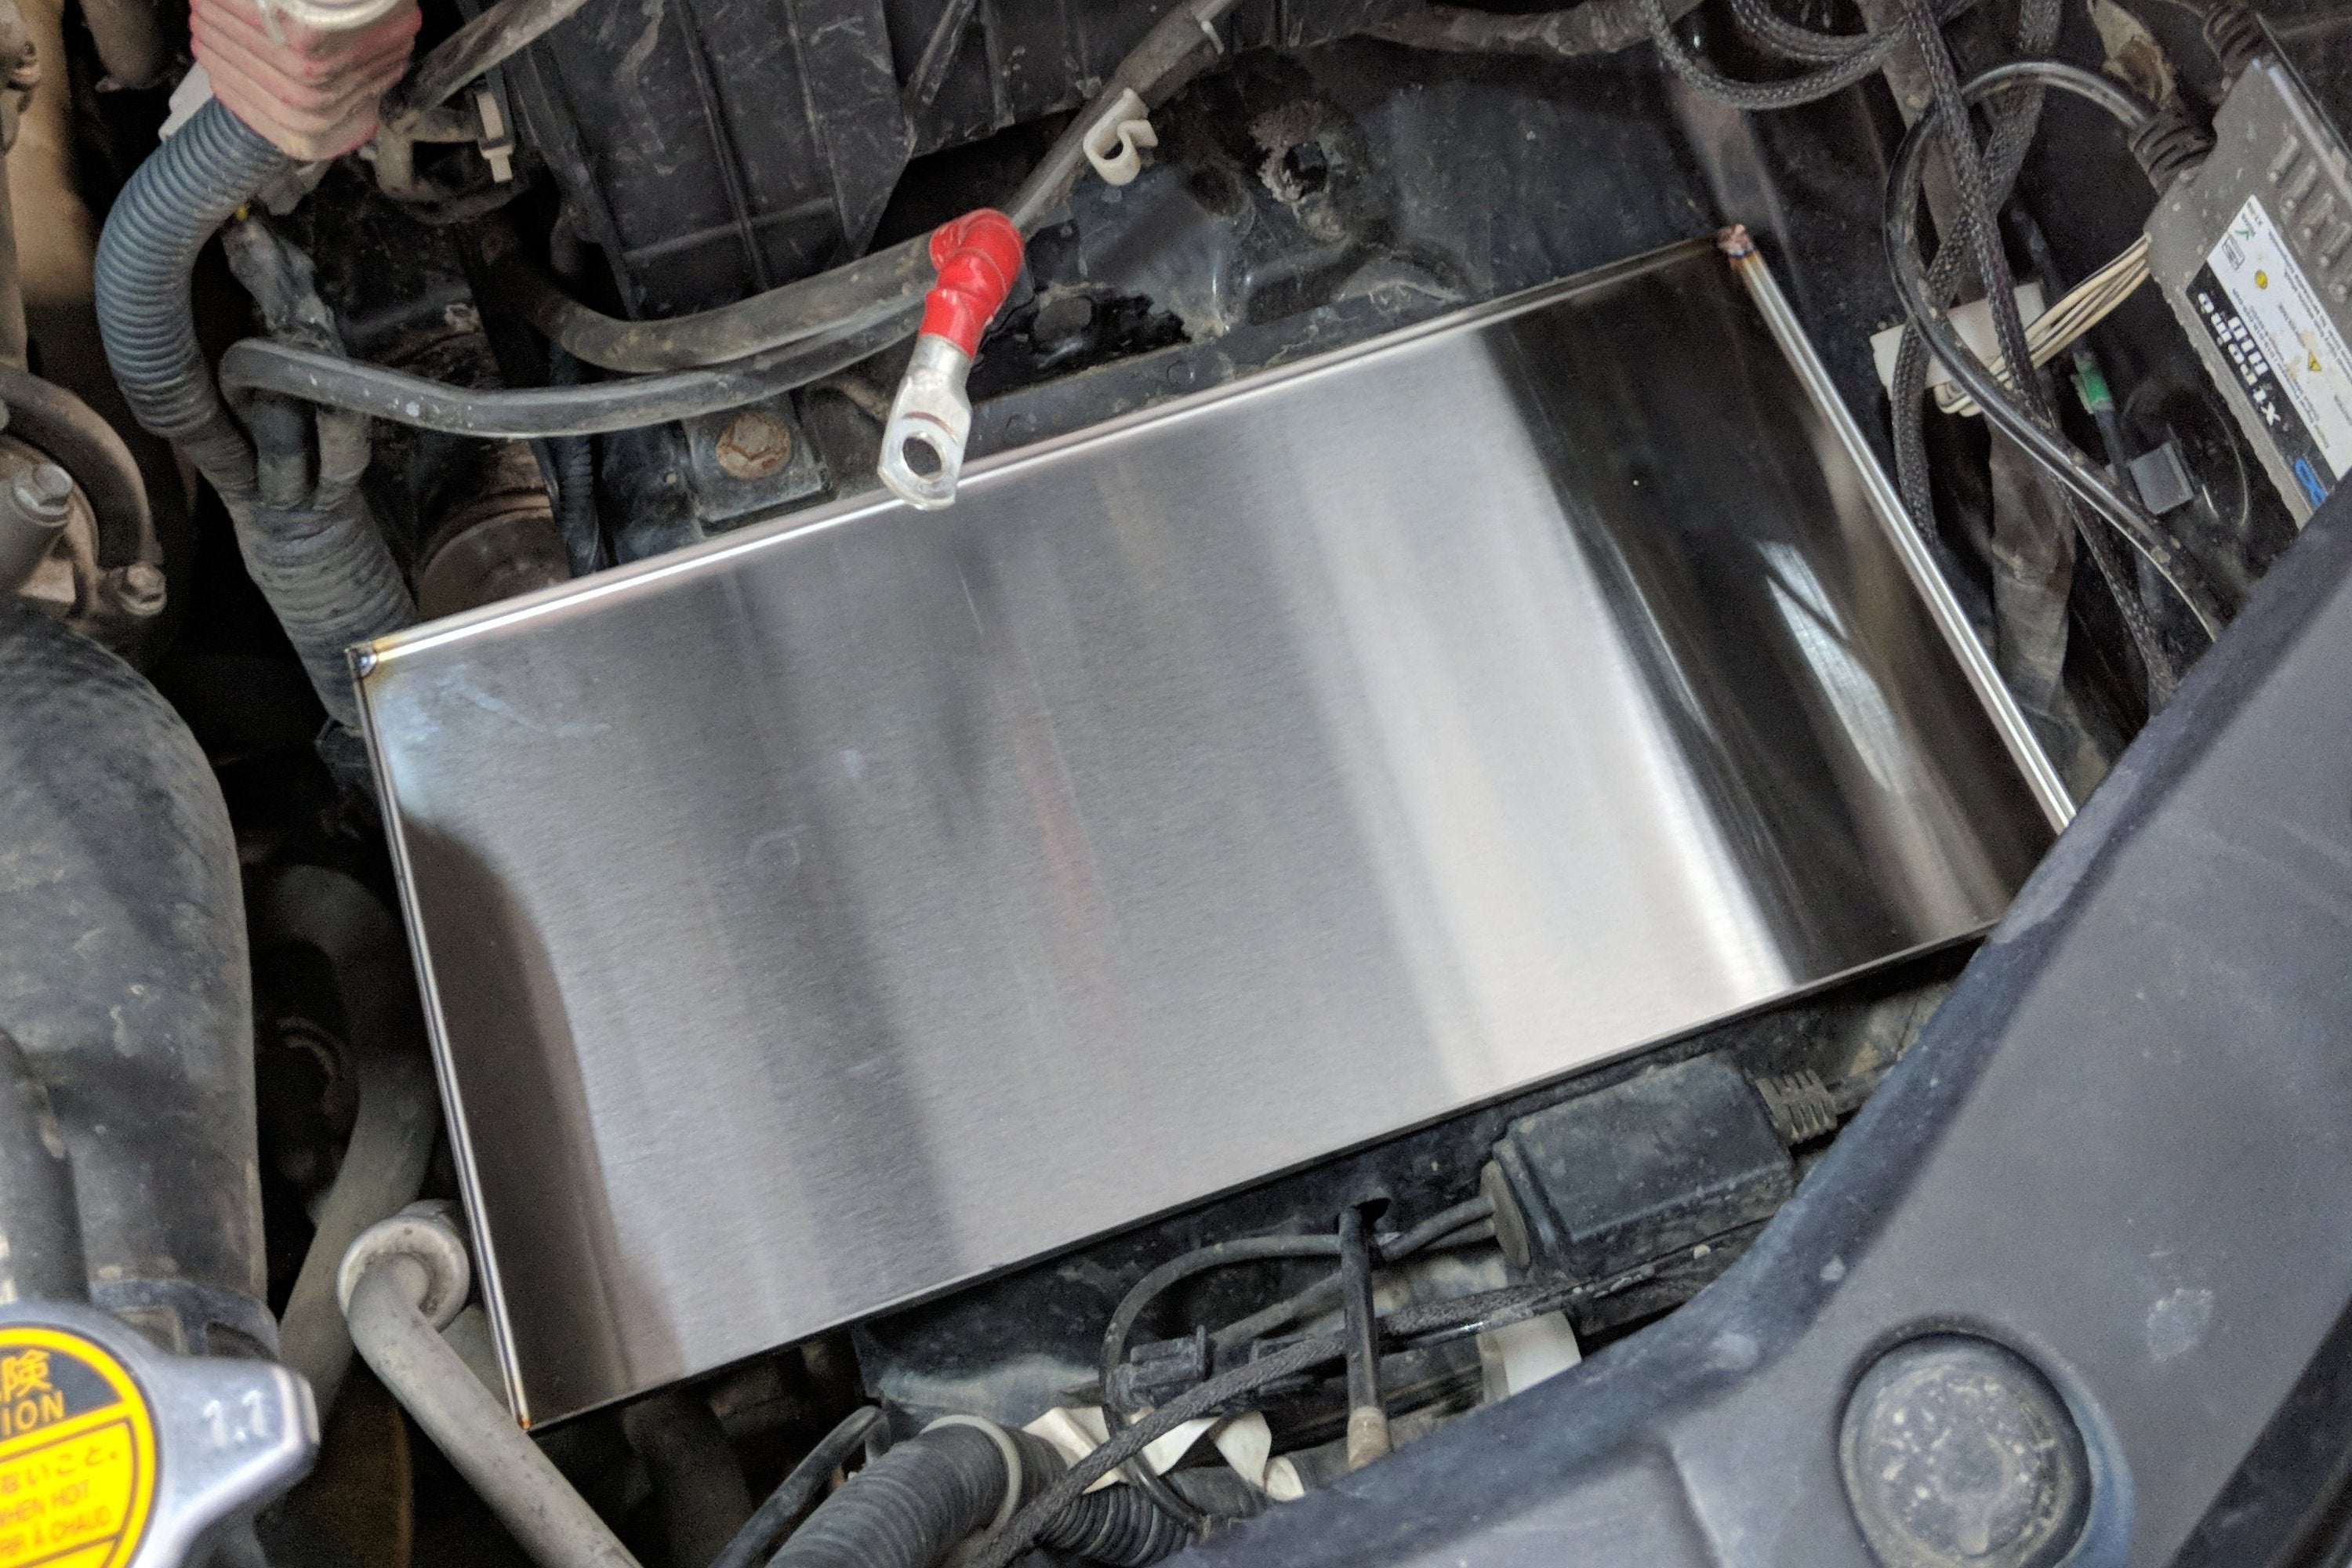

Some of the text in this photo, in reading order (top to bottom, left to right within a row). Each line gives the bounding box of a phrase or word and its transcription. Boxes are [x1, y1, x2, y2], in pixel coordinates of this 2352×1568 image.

[2198, 292, 2281, 426] Xtreme
[2227, 316, 2269, 376] HID
[2, 1390, 64, 1436] ION
[202, 1389, 268, 1449] 1.1
